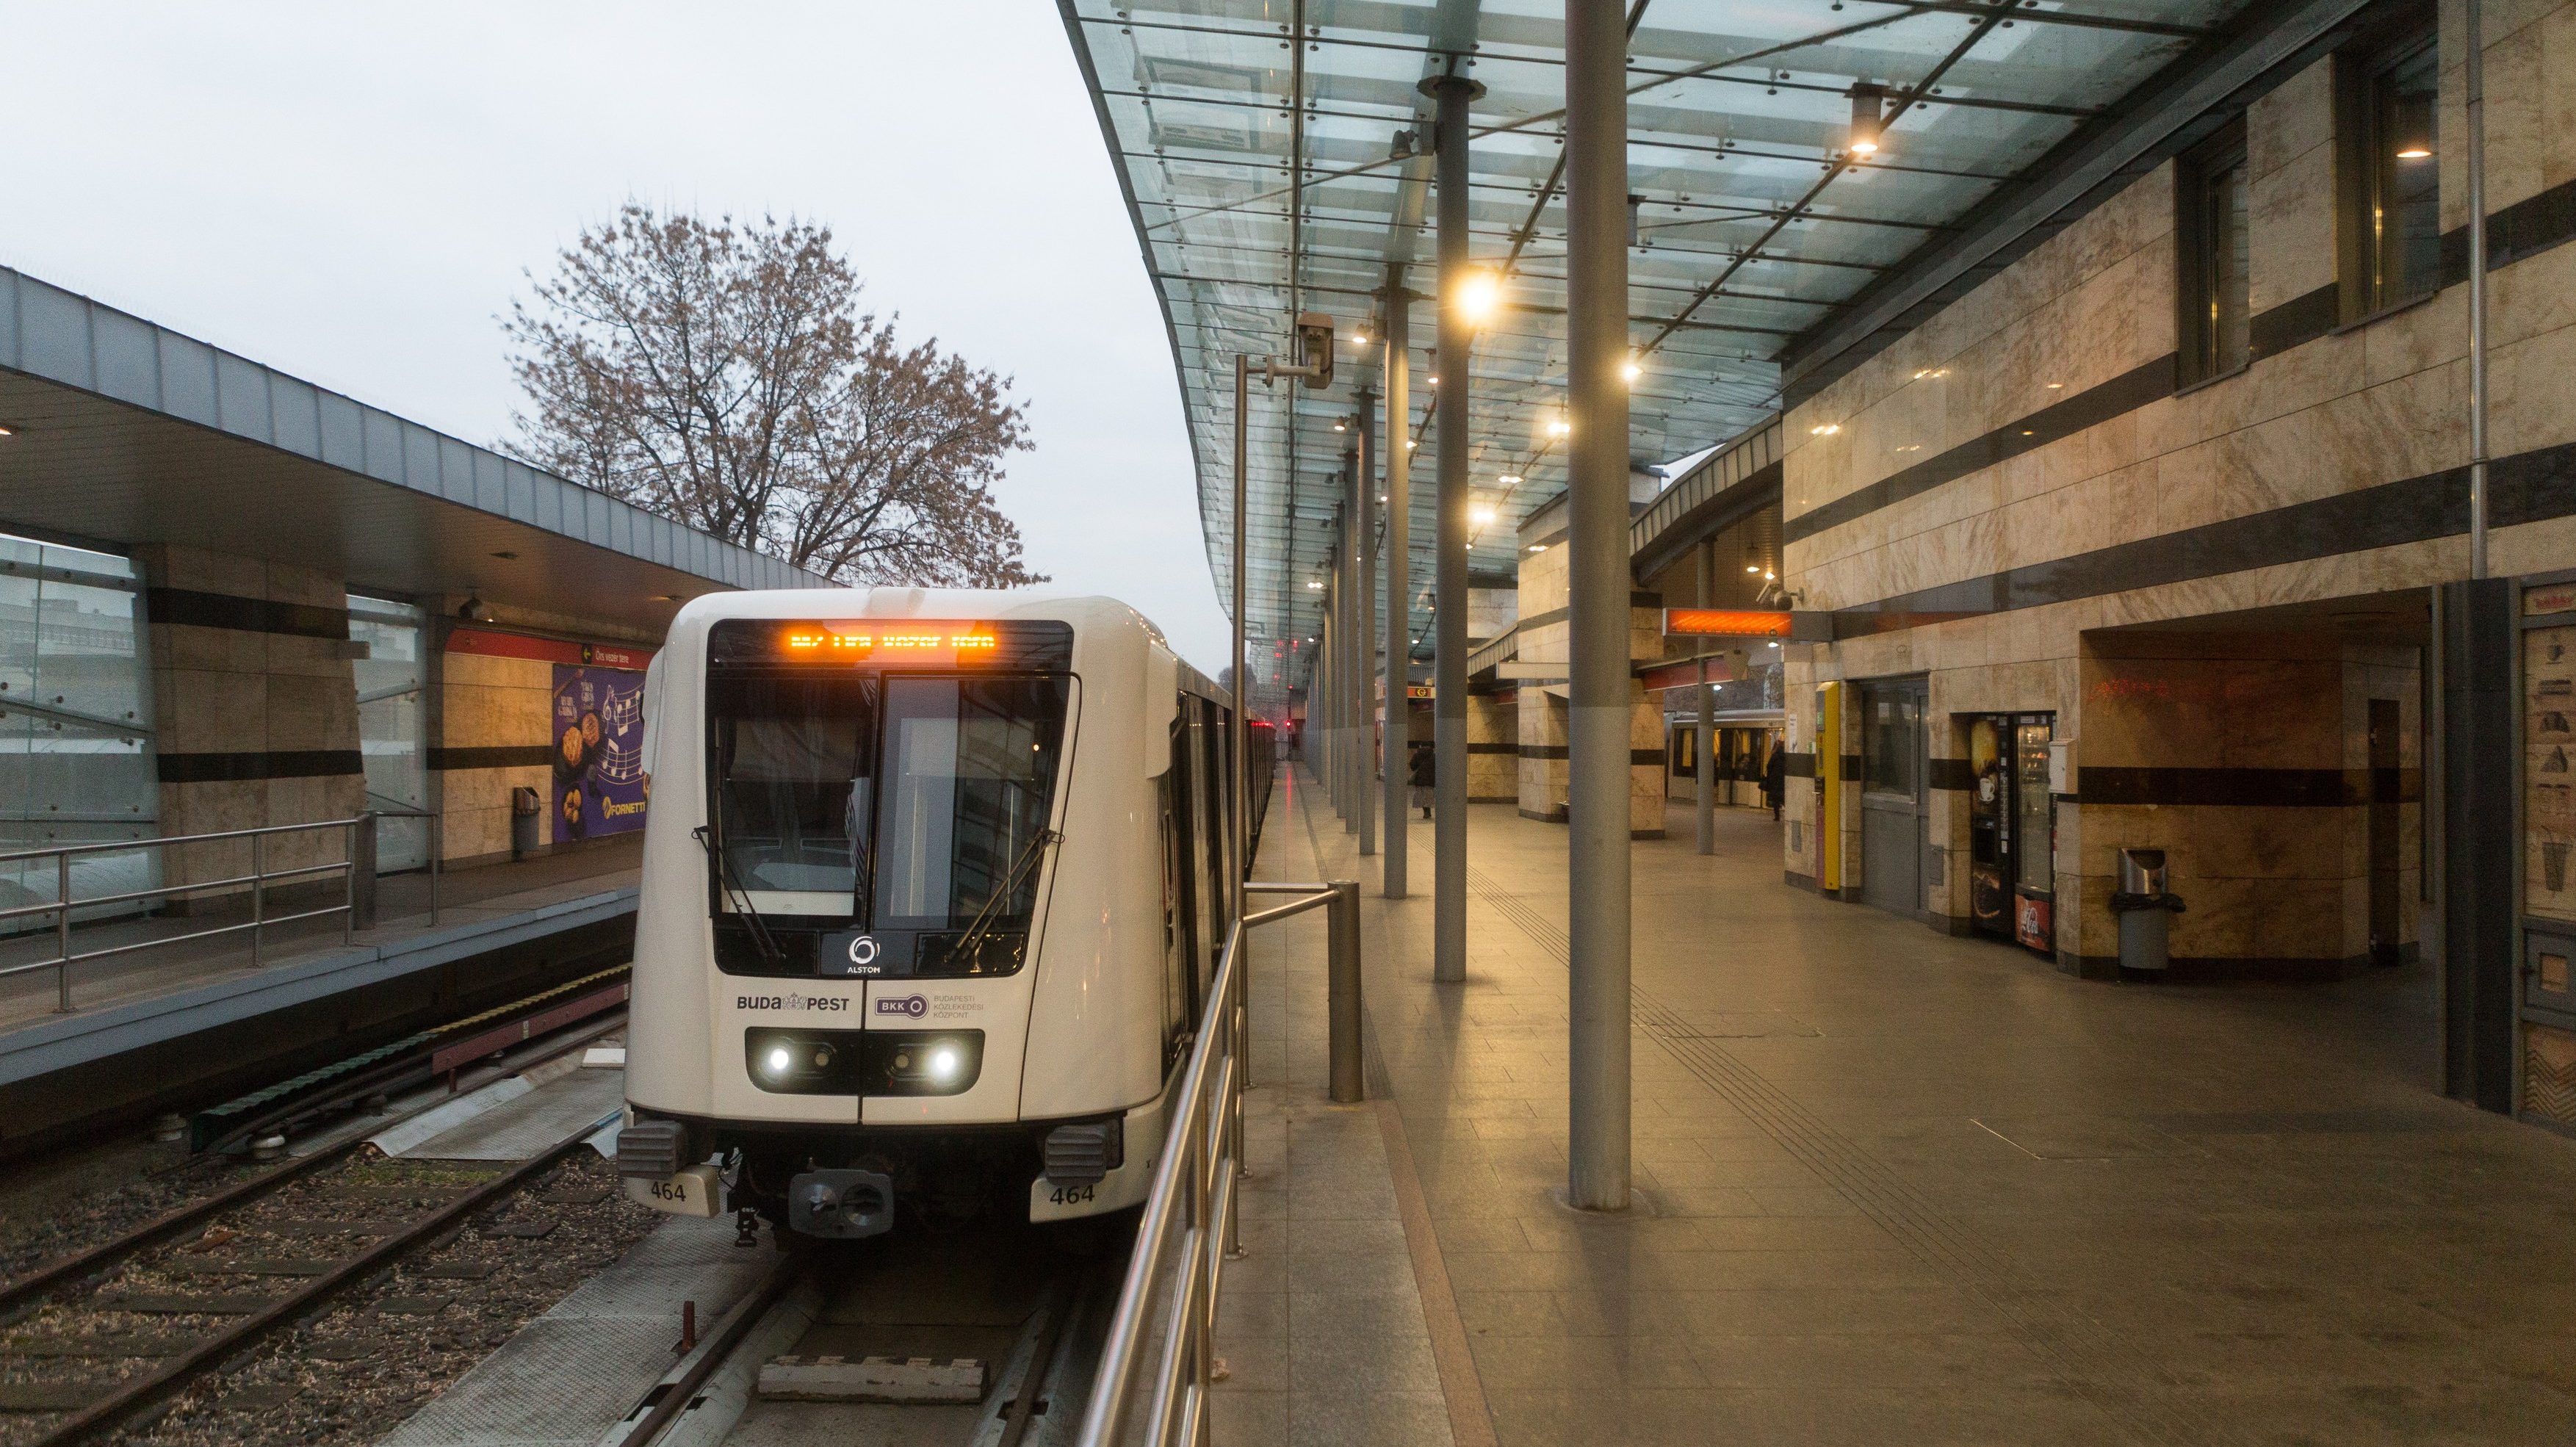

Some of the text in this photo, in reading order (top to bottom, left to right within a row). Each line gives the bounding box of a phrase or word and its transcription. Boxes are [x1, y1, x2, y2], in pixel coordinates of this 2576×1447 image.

[611, 802, 646, 816] FORNETTI
[881, 1002, 905, 1011] BKK
[934, 1003, 984, 1011] KÖZLEKEDÉSI
[934, 1011, 969, 1019] KÖZPONT
[652, 1181, 686, 1202] 464
[1050, 1184, 1094, 1205] 464
